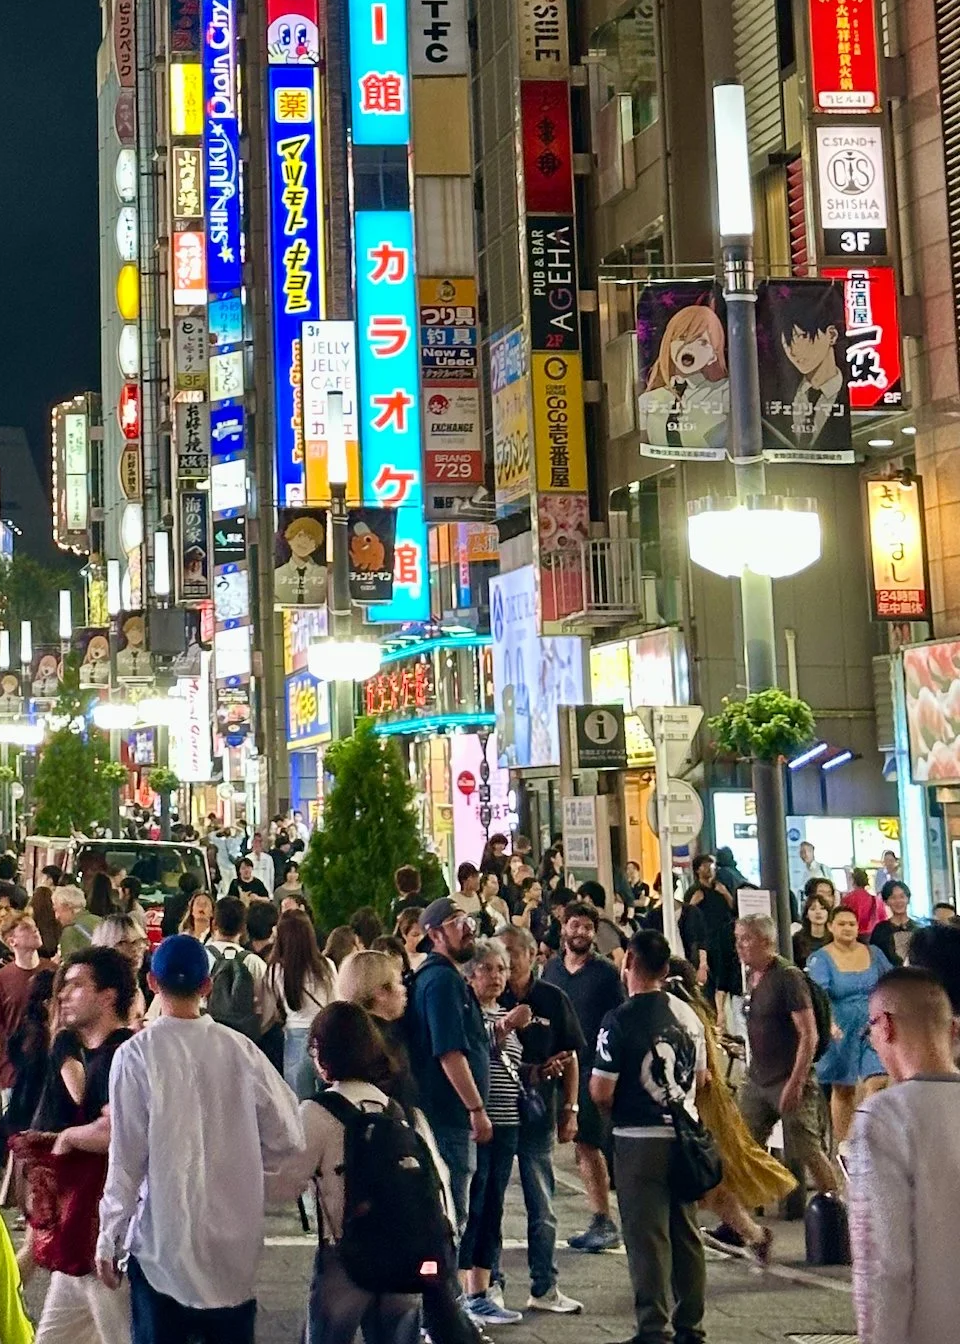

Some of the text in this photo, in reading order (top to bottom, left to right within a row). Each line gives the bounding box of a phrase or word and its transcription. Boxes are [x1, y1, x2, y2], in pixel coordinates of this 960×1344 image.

[421, 0, 451, 63] TFC
[279, 92, 306, 118] 薬
[827, 199, 880, 210] SHISHA
[278, 137, 310, 311] マツモトキヨシ
[841, 232, 870, 252] 3F
[532, 229, 546, 296] PUB & BAR
[546, 226, 574, 332] AGEHA
[851, 273, 868, 323] 居酒屋
[421, 306, 475, 325] つり具
[307, 326, 320, 337] 3F
[426, 327, 472, 345] 釣具
[311, 341, 350, 354] JELLY
[422, 347, 471, 357] New &
[311, 359, 350, 372] JELLY
[436, 357, 474, 366] Used
[185, 375, 200, 386] 3F
[311, 376, 352, 390] CAFE
[884, 392, 902, 403] 2F
[770, 400, 845, 417] チェンソーマン
[312, 421, 352, 435] カェ
[431, 423, 474, 433] EXCHANGE
[434, 454, 472, 462] BRAND
[434, 464, 472, 478] 729
[185, 497, 202, 544] 海の家
